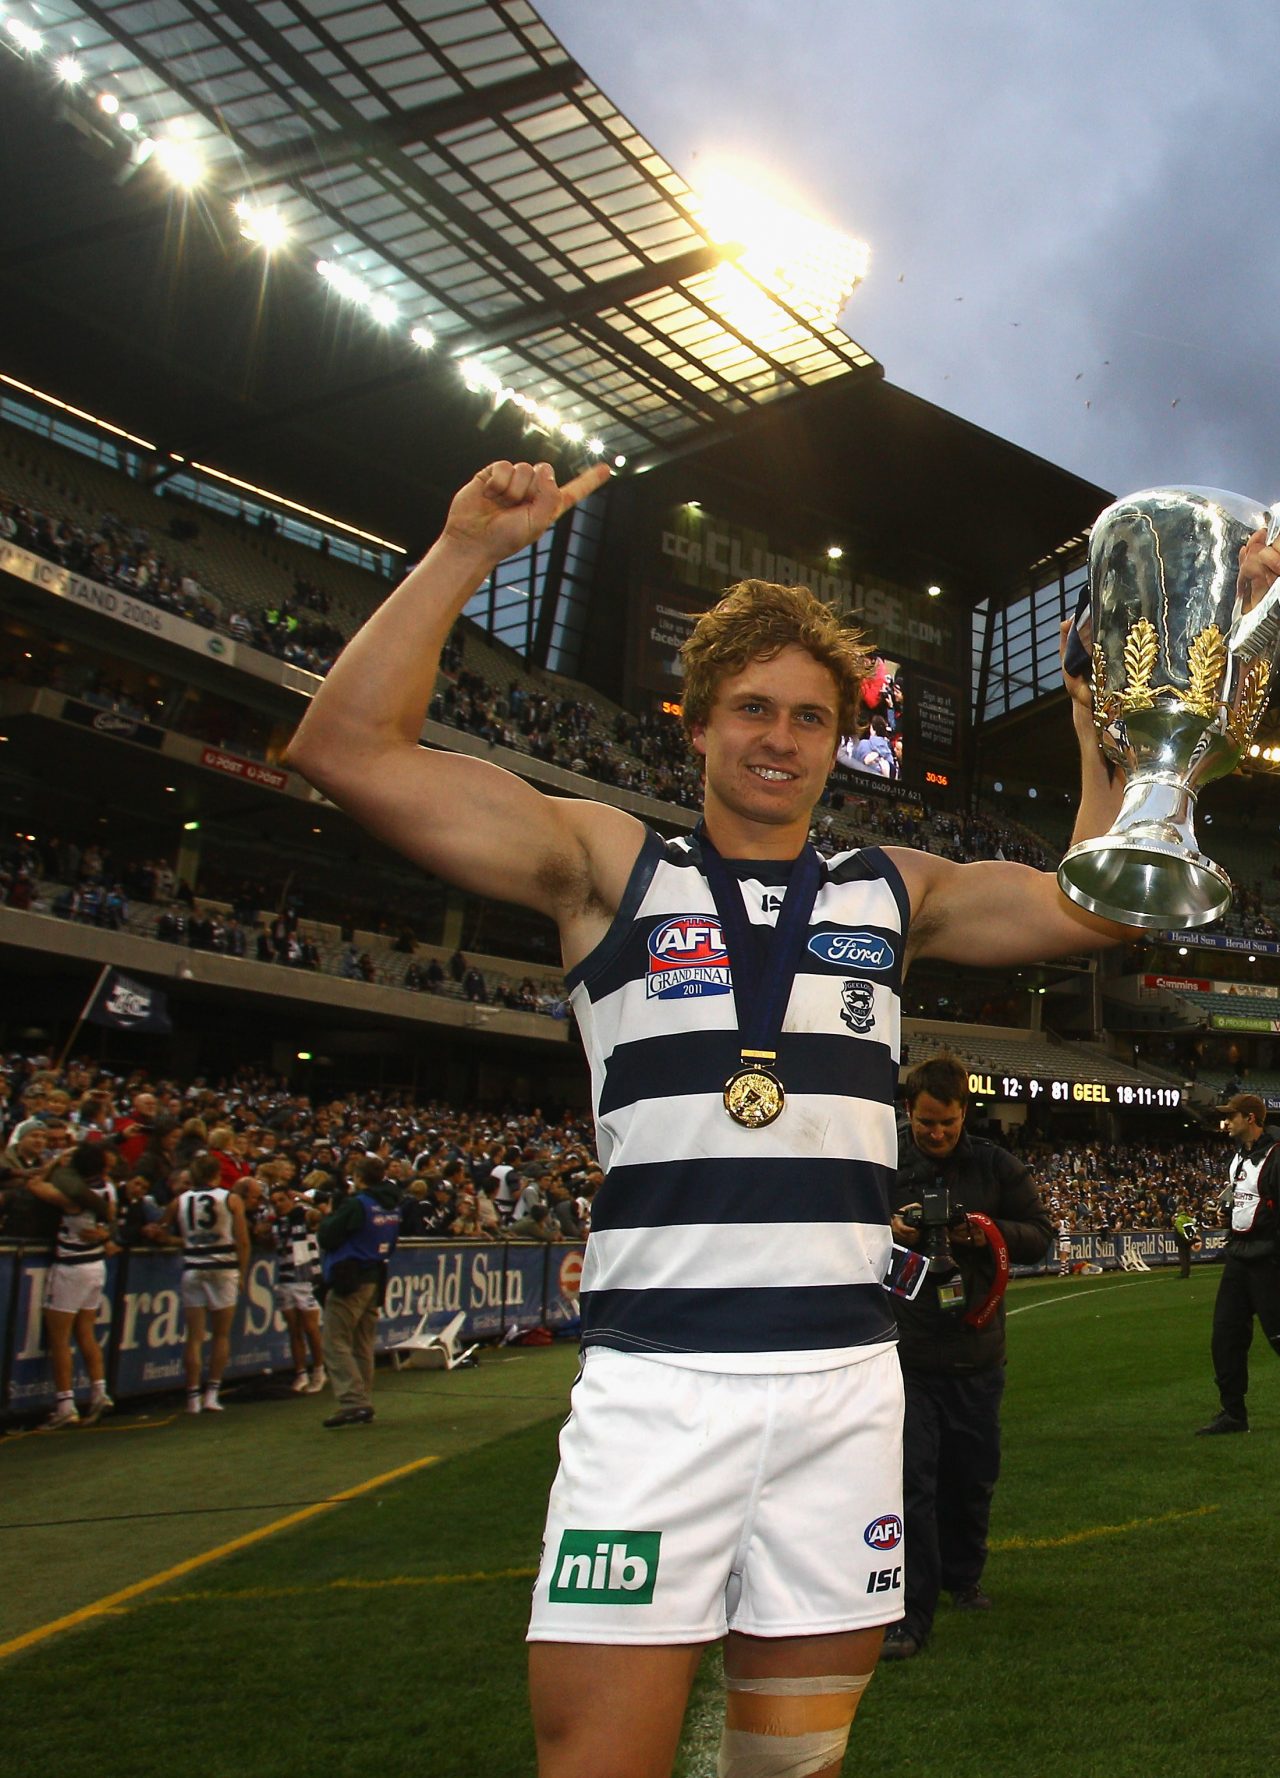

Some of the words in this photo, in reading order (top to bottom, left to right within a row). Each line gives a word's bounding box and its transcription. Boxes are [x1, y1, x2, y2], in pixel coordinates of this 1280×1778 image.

[58, 572, 117, 612] STAND
[123, 601, 163, 630] 2006
[650, 628, 687, 648] faceb
[216, 756, 244, 774] POST
[257, 770, 284, 788] POST
[926, 772, 948, 786] 30:36
[656, 927, 727, 954] AFL
[1172, 932, 1199, 945] Herald
[1200, 935, 1216, 946] Sun
[1226, 939, 1251, 950] Herald
[1253, 941, 1267, 952] Sun
[827, 936, 885, 966] Ford
[650, 969, 692, 993] GRAND
[683, 983, 703, 996] 2011
[1156, 977, 1198, 991] Cummins
[968, 1074, 996, 1095] OLL
[1051, 1081, 1068, 1100] 81
[1073, 1083, 1110, 1103] GEEL
[187, 1195, 217, 1232] 13
[1098, 1239, 1115, 1258] Sun
[1123, 1235, 1155, 1255] Herald
[999, 1248, 1007, 1270] EOS
[378, 1254, 462, 1319] erald
[470, 1252, 523, 1309] Sun
[868, 1522, 902, 1544] AFL
[556, 1543, 649, 1592] nib
[866, 1566, 902, 1594] ISC
